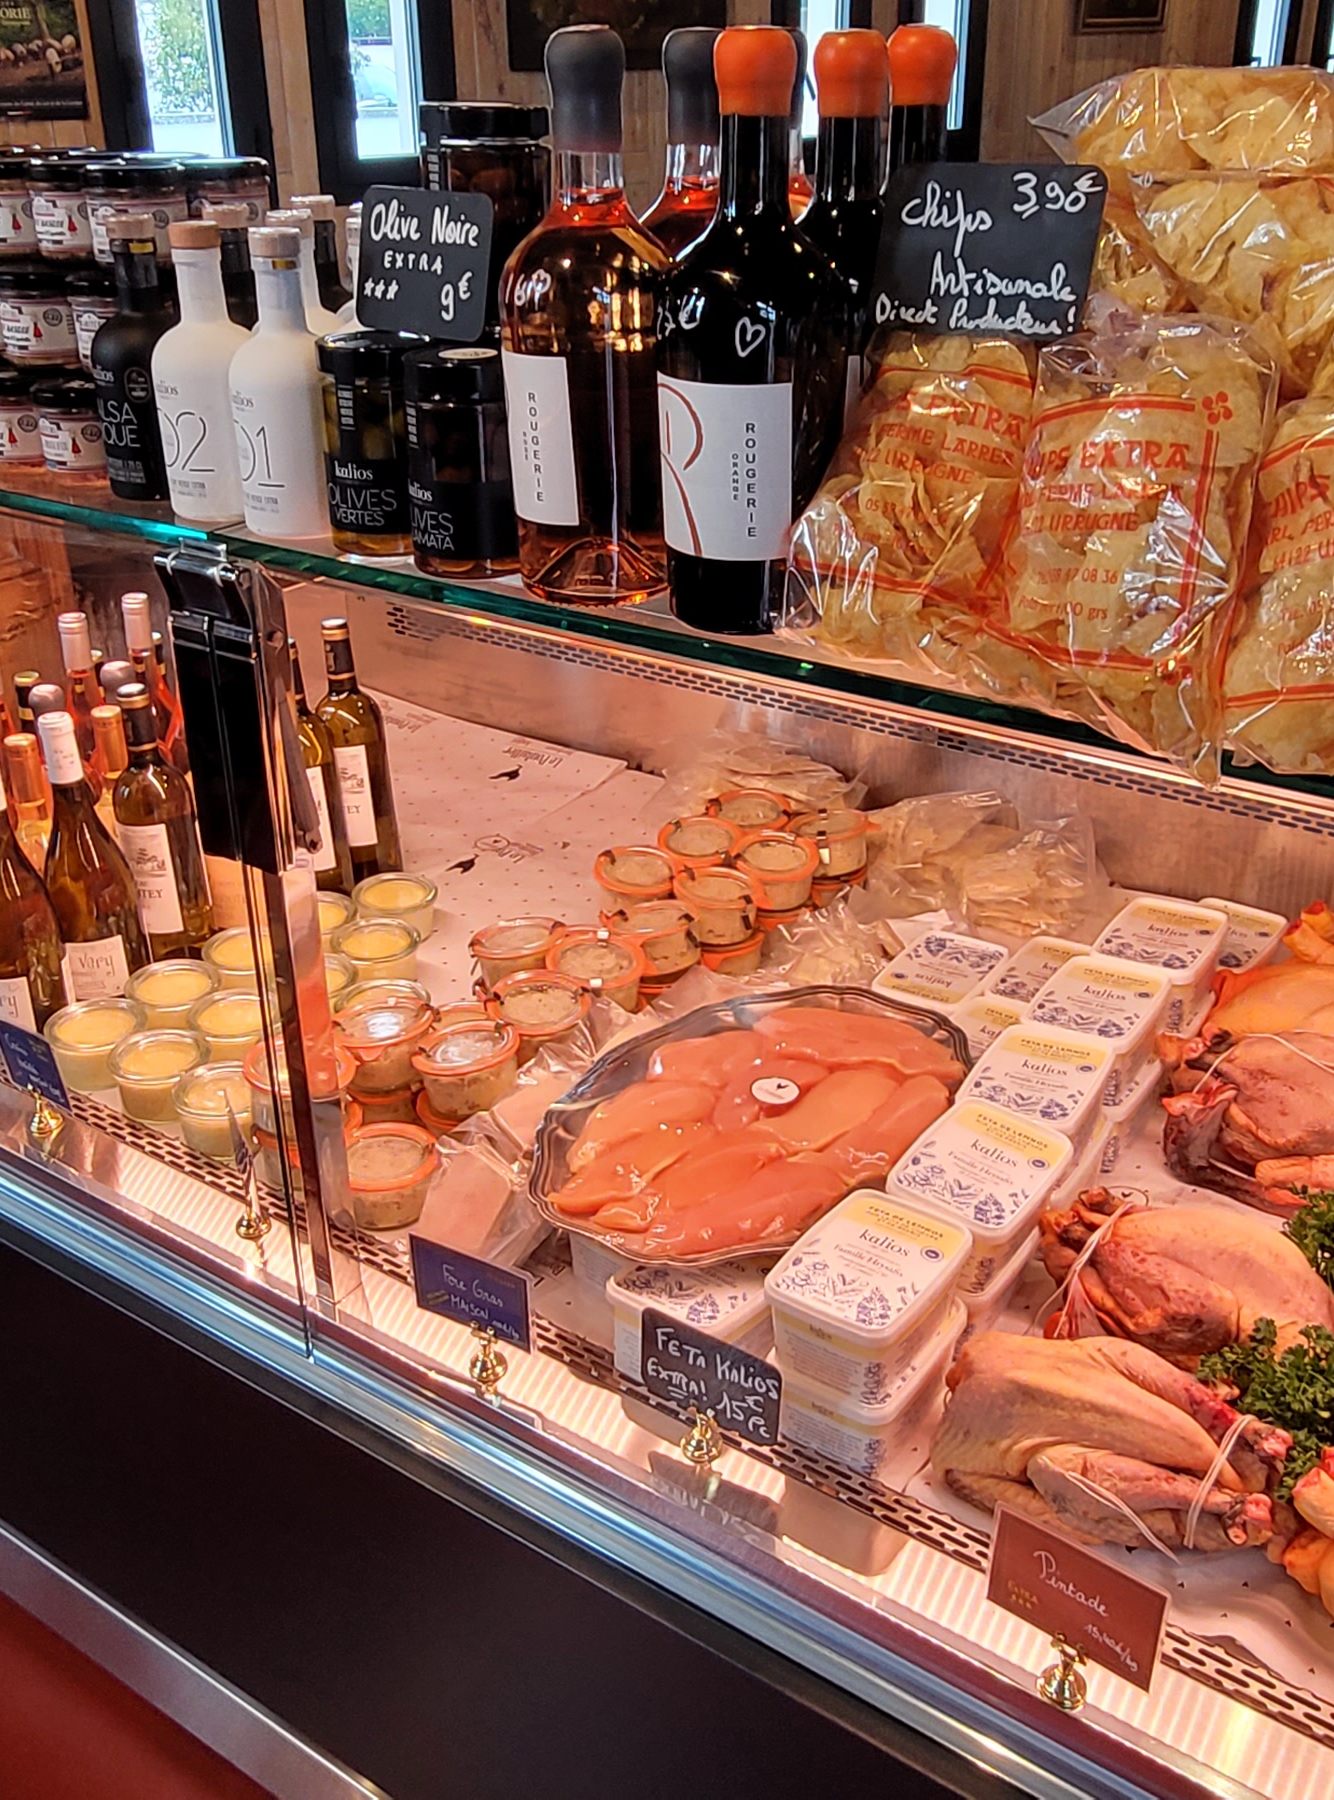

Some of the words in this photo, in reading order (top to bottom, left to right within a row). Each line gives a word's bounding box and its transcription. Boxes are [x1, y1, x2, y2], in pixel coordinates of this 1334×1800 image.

[370, 198, 421, 242] Olive
[431, 204, 480, 247] Noire
[383, 250, 443, 275] EXTRA
[875, 293, 939, 325] Direct
[929, 393, 1027, 441] EXTRA
[527, 392, 545, 502] ROUGERIE
[879, 423, 935, 446] FERME
[1079, 440, 1190, 470] EXTRA
[334, 460, 373, 480] kalios
[731, 453, 740, 501] ORANGE
[744, 422, 758, 538] ROUGERIE
[328, 482, 397, 511] OLIVES
[335, 508, 385, 526] VERTES
[1049, 512, 1140, 532] URRUGNE
[1082, 568, 1098, 584] 08
[1101, 569, 1118, 584] 36
[1021, 1058, 1068, 1077] kalios
[970, 1138, 1018, 1168] kalios
[859, 1228, 911, 1257] kalios
[1033, 1550, 1110, 1618] Pintade
